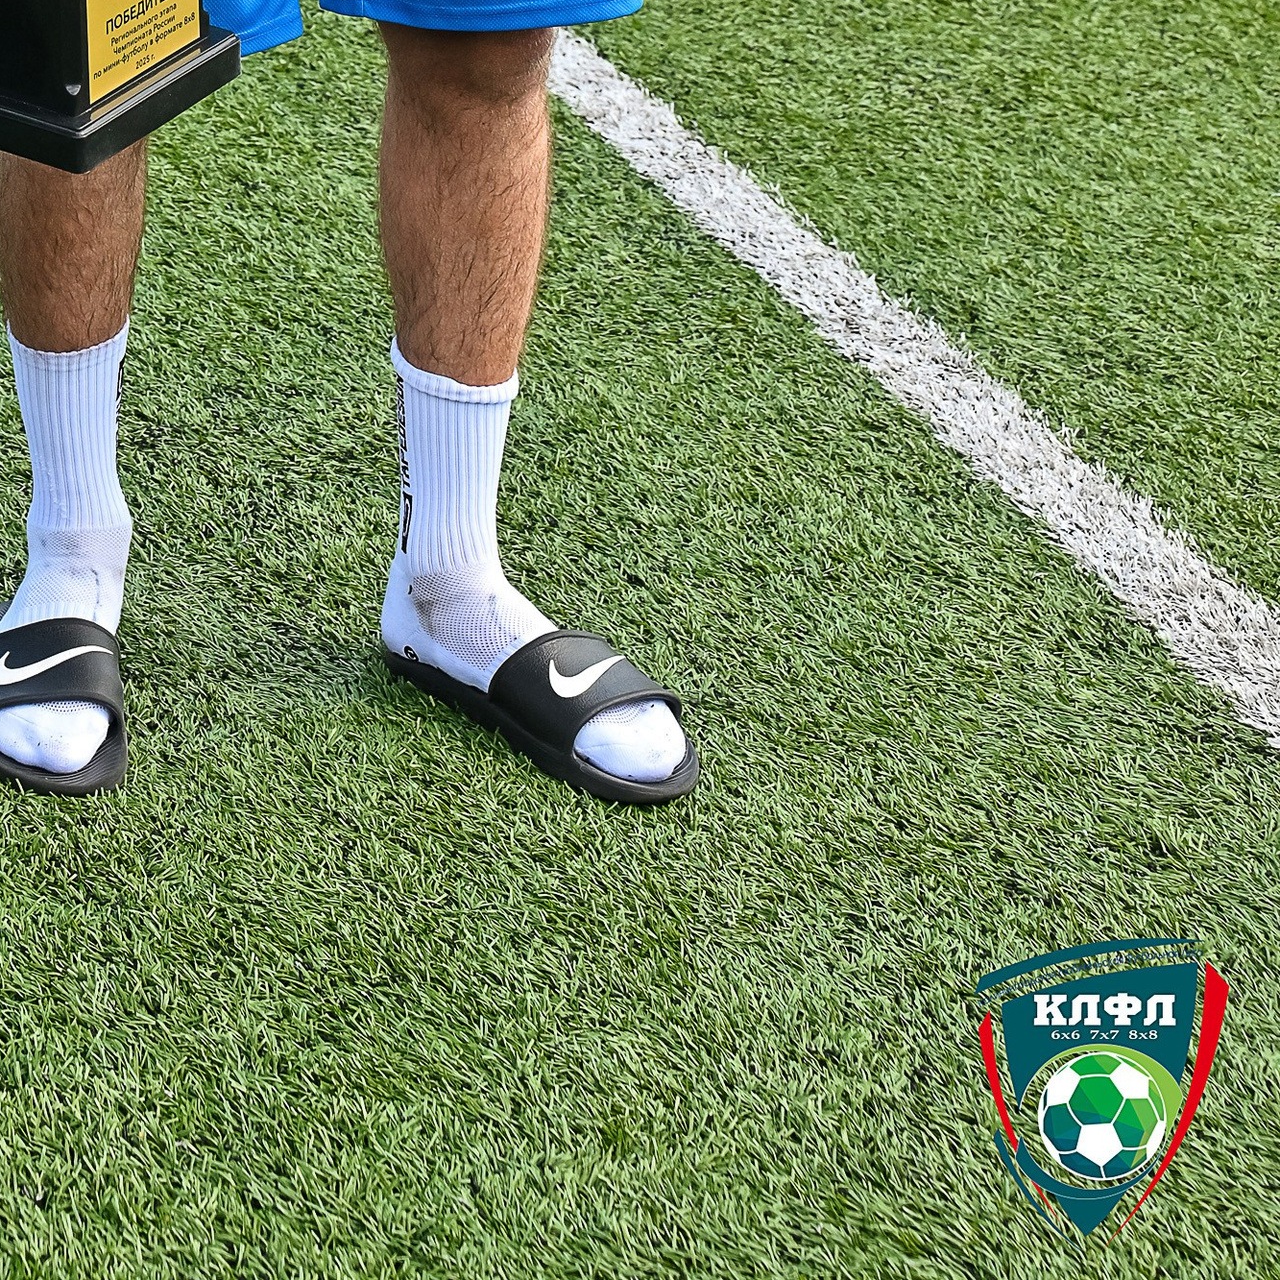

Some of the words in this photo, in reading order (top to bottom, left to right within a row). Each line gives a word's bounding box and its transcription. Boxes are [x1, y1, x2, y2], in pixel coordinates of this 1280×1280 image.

[110, 12, 158, 47] Регионального
[160, 3, 177, 18] этапа
[113, 26, 152, 55] Чемпионата
[153, 15, 175, 33] России
[93, 70, 102, 80] по
[103, 42, 148, 73] мини-футболу
[154, 20, 183, 44] формате
[135, 56, 150, 70] 2025
